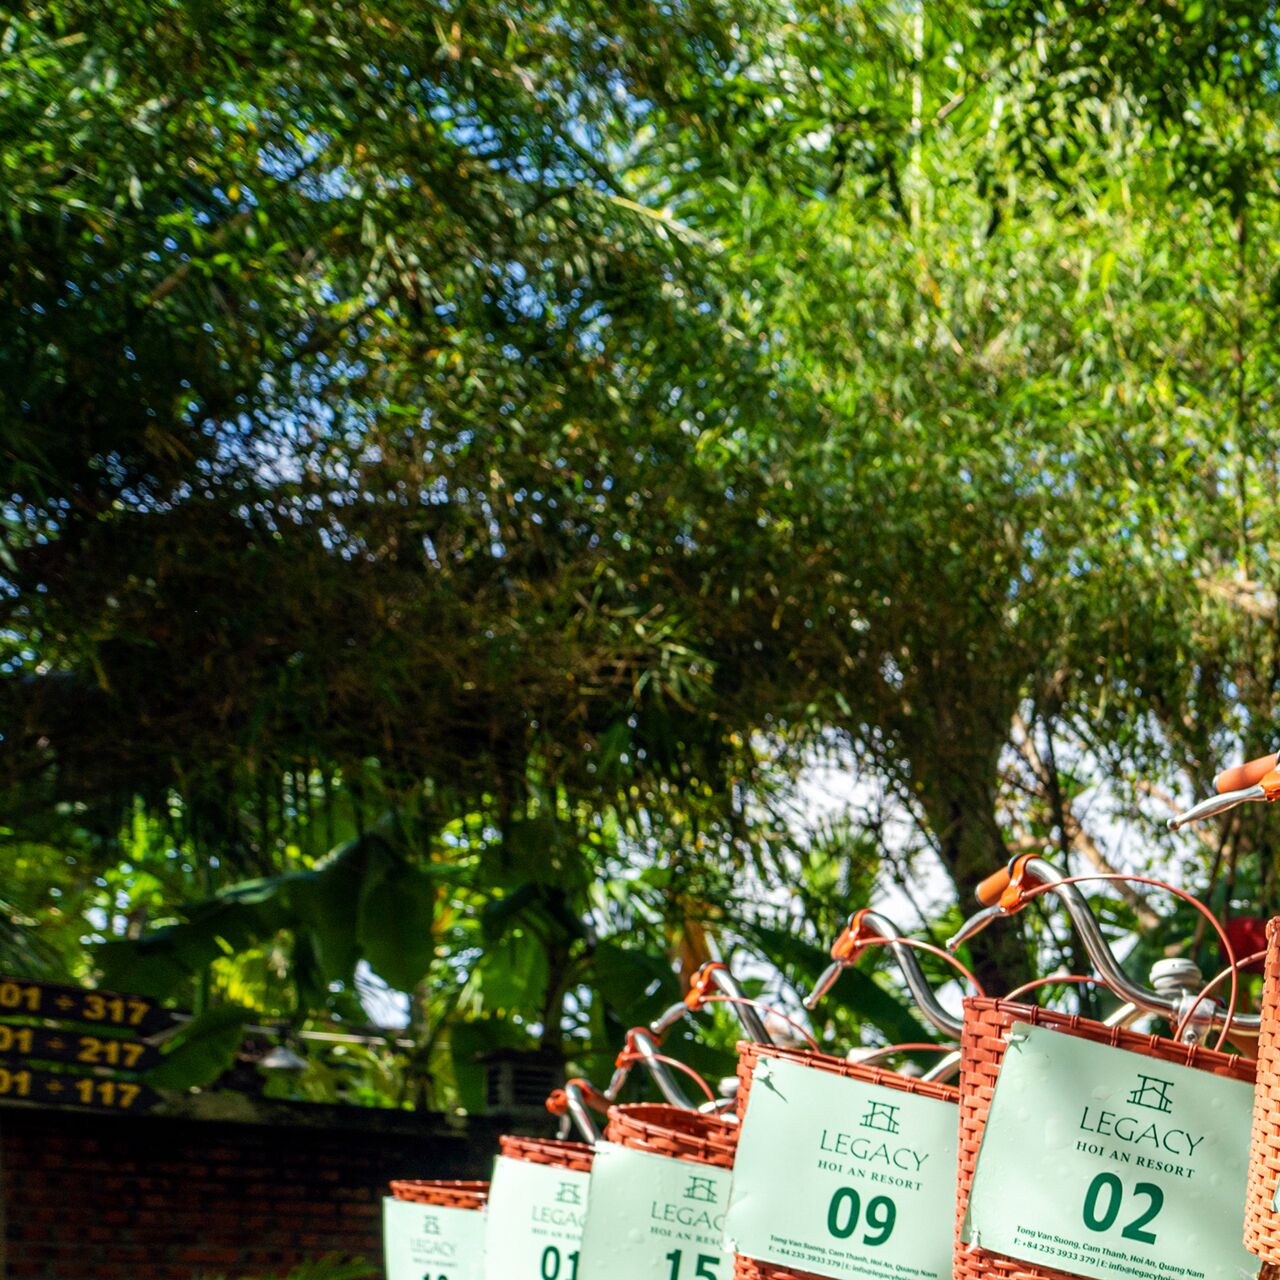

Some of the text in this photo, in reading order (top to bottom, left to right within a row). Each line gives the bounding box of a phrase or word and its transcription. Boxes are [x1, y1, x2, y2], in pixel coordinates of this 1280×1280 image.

[82, 993, 150, 1025] 317
[78, 1036, 145, 1067] 217
[75, 1078, 140, 1109] 117
[1079, 1106, 1205, 1157] LEGACY
[819, 1129, 929, 1172] LEGACY
[1076, 1140, 1195, 1179] HOI AN RESORT
[817, 1159, 923, 1191] HOI AN RESORT
[531, 1205, 584, 1228] LEGA
[651, 1201, 725, 1232] LEGAC
[826, 1186, 897, 1247] 09
[1082, 1171, 1164, 1246] 02
[1016, 1225, 1037, 1239] Tong
[1037, 1231, 1053, 1241] Van
[1053, 1235, 1081, 1250] Suong,
[1082, 1242, 1101, 1254] Cam
[1102, 1247, 1129, 1262] Thanh,
[1129, 1254, 1145, 1265] Hoi
[1158, 1261, 1186, 1276] Quang
[1185, 1268, 1205, 1279] Nam
[1022, 1241, 1038, 1250] +84
[1038, 1244, 1056, 1255] 235
[1056, 1248, 1079, 1261] 3933
[1079, 1254, 1096, 1265] 379
